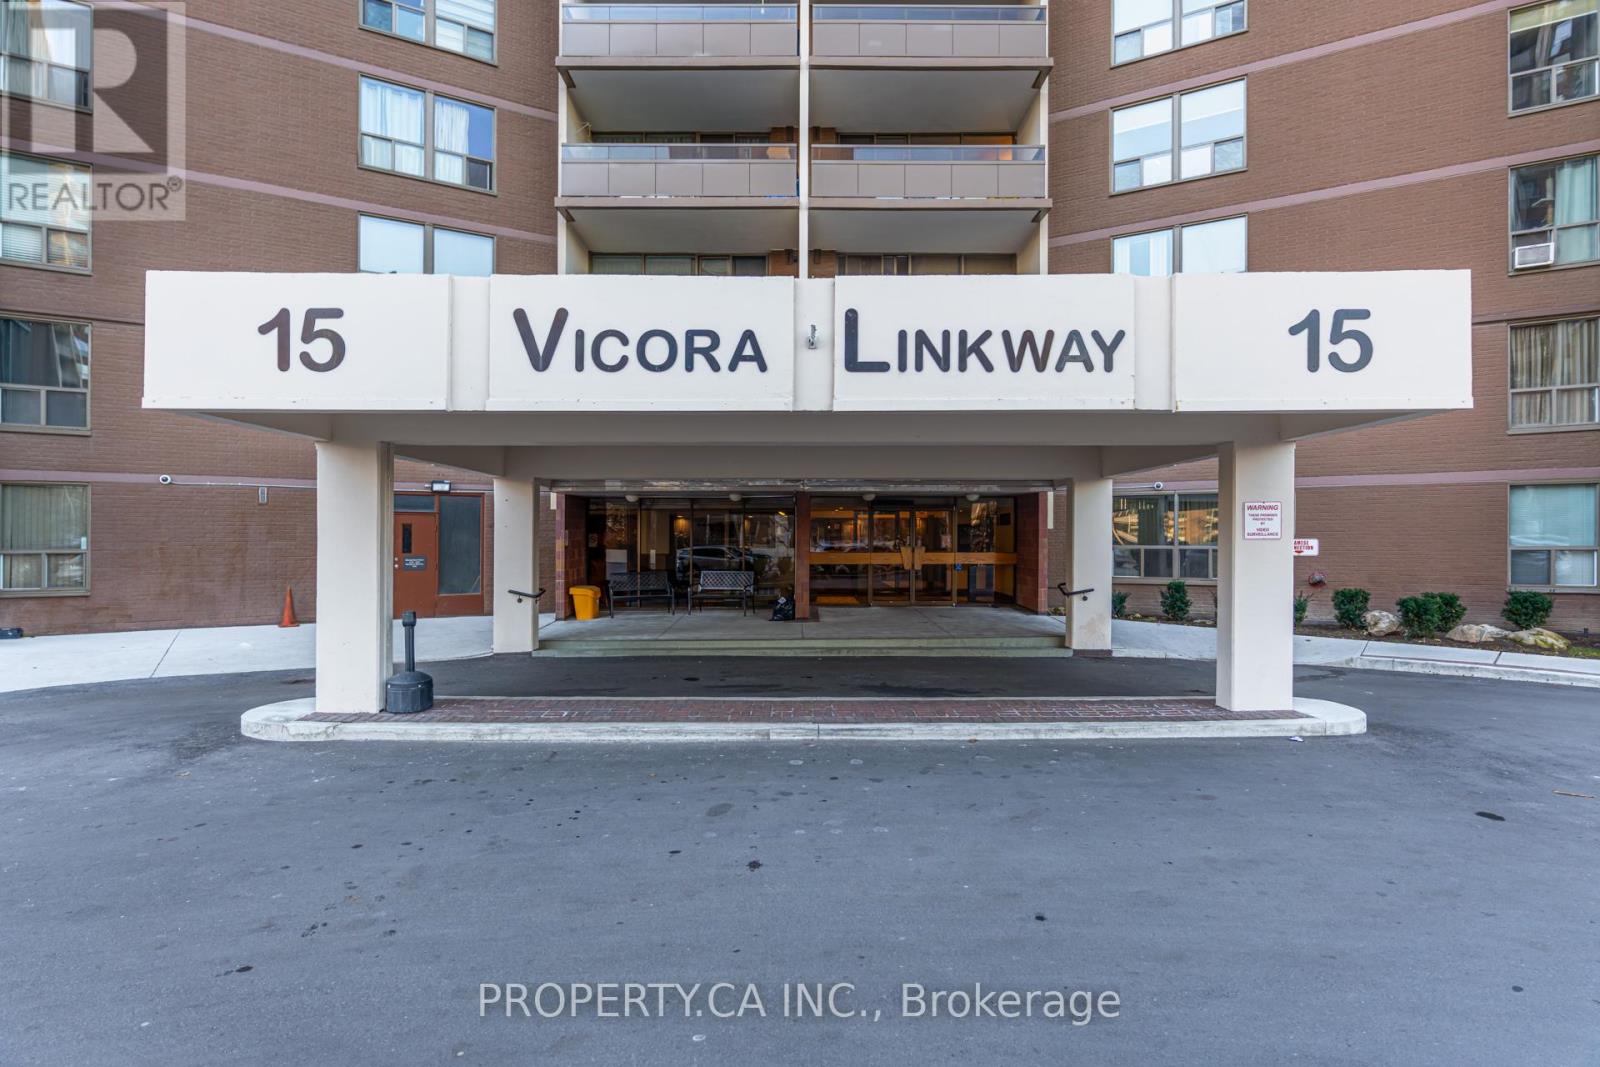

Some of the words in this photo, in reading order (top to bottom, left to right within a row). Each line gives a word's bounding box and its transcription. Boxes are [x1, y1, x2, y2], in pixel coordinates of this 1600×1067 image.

[258, 308, 345, 372] 15
[513, 308, 767, 373] VICORA
[845, 309, 1125, 373] LINKWAY
[1289, 309, 1373, 373] 15
